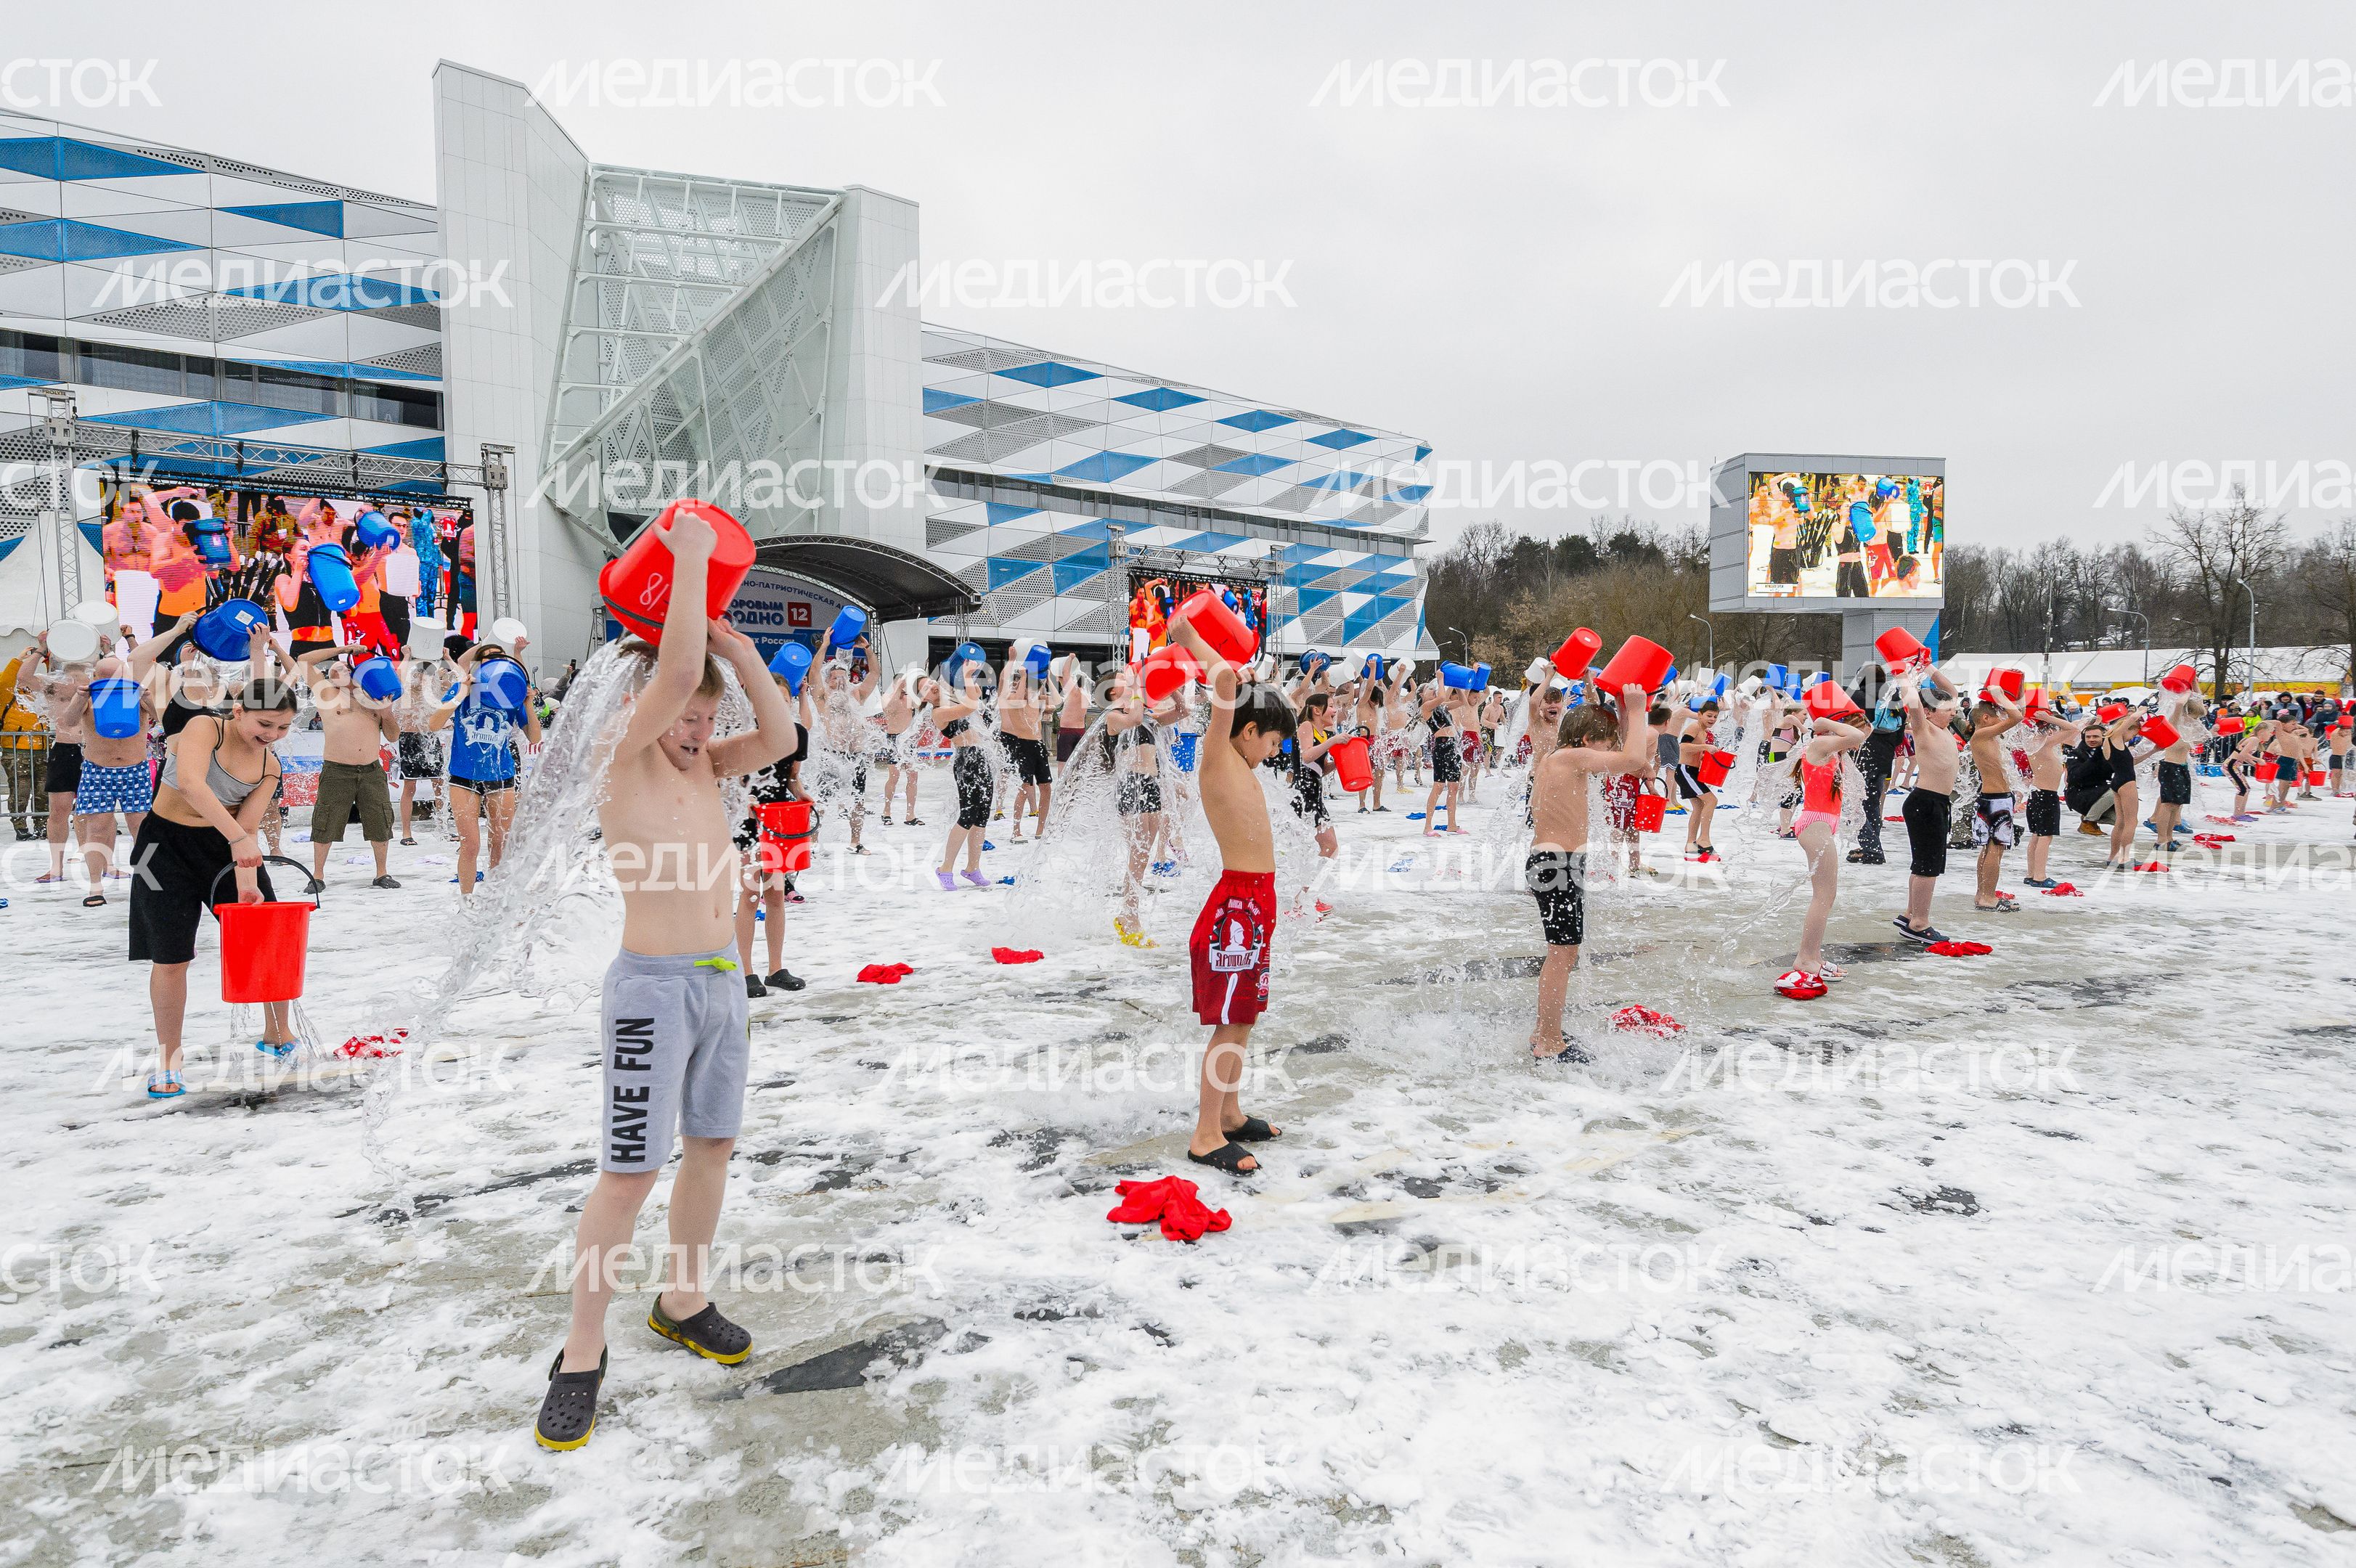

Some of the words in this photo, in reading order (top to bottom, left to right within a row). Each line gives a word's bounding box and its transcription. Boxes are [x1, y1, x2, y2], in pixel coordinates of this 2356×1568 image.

[741, 580, 835, 606] НО-ПАТРИОТИЧЕСКАЯ
[791, 608, 808, 621] 12
[613, 1018, 654, 1071] FUN
[611, 1085, 650, 1163] HAVE
